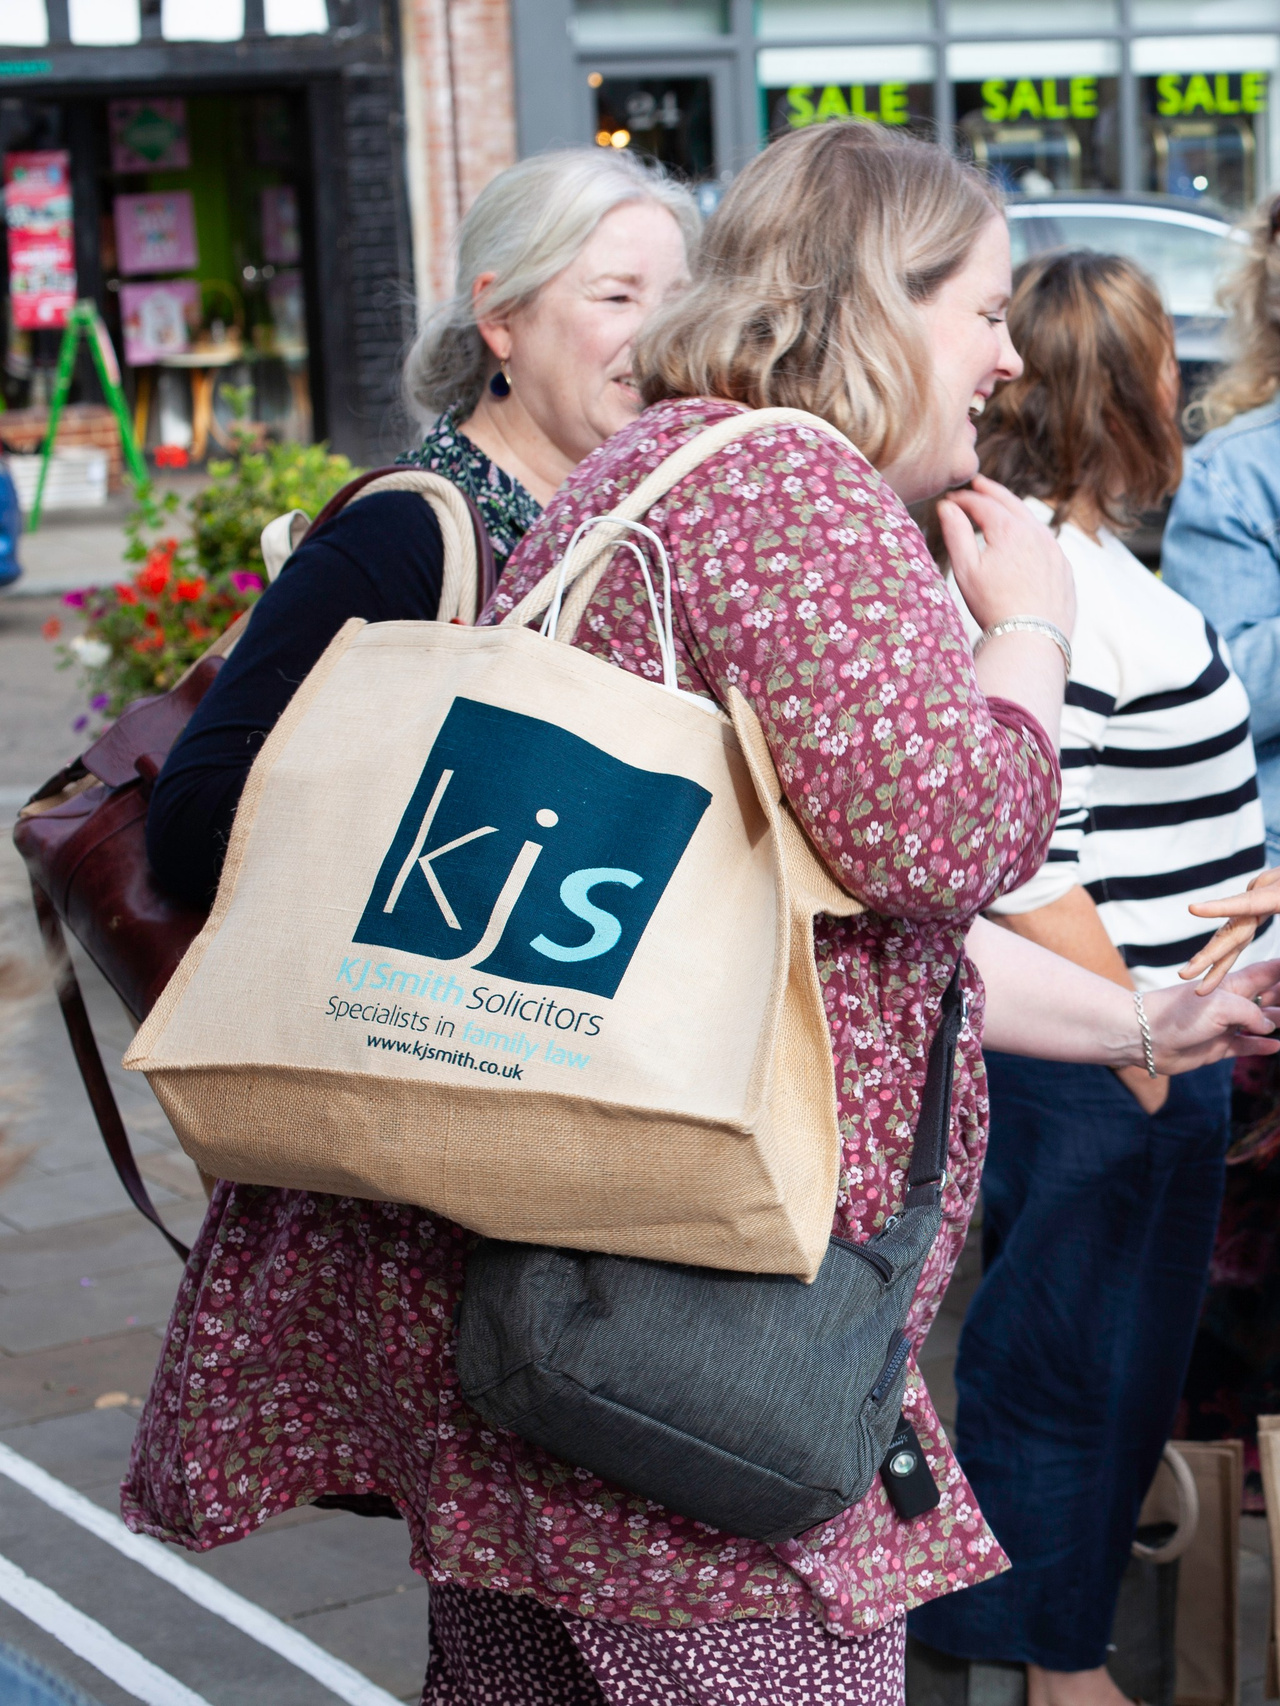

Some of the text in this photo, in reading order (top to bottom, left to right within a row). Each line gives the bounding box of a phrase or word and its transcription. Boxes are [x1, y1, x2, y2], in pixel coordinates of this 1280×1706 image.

[787, 81, 909, 127] SALE
[981, 76, 1098, 121] SALE
[1156, 70, 1268, 117] SALE
[383, 769, 644, 968] kjs
[336, 956, 604, 1036] KJSmith Solicitors
[325, 995, 593, 1070] Specialists in family law
[367, 1034, 524, 1080] www.kjsmith.co.uk
